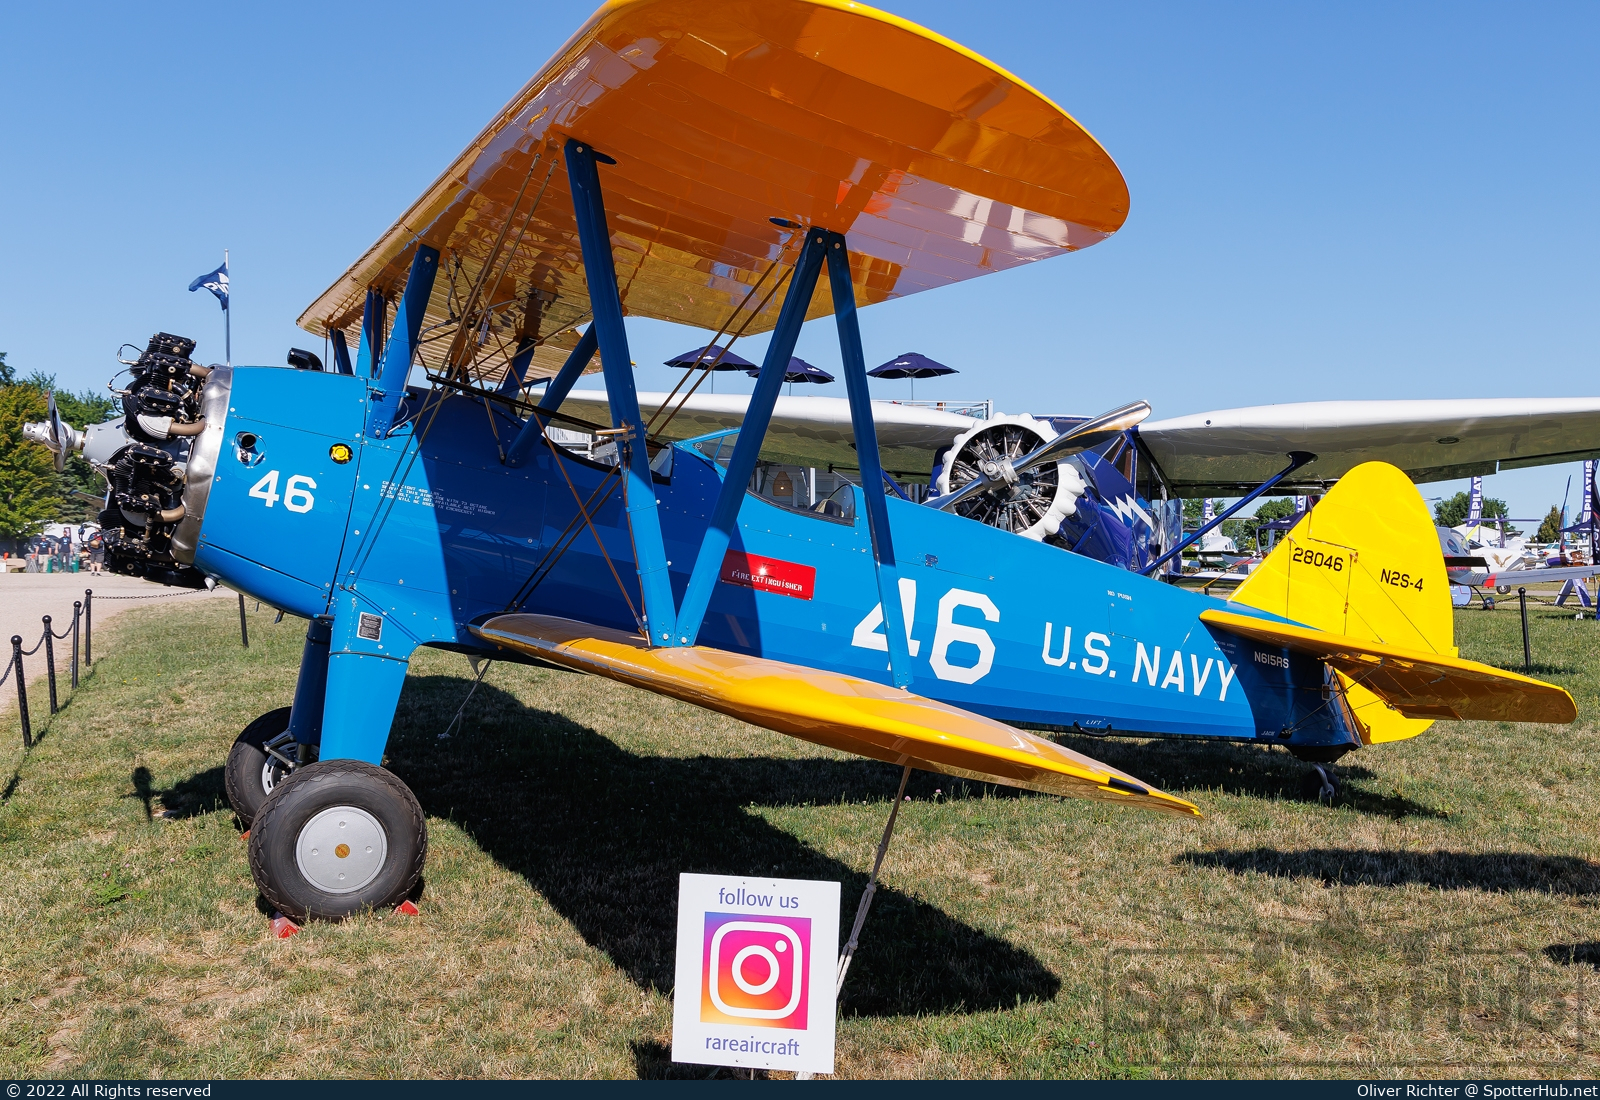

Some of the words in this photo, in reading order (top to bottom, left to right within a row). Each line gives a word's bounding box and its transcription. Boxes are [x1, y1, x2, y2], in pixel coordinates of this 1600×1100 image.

[248, 470, 317, 514] 46
[1292, 547, 1344, 572] 28046
[731, 569, 750, 581] FIRE
[751, 574, 803, 592] EXTINGUISHER
[1380, 568, 1424, 592] N2S-4
[851, 577, 1000, 685] 46
[1041, 621, 1117, 678] U.S.
[1131, 641, 1238, 702] NAVY
[1254, 651, 1290, 669] N615RS
[718, 887, 773, 908] follow
[779, 895, 799, 909] us
[705, 1036, 800, 1056] rareaircraft
